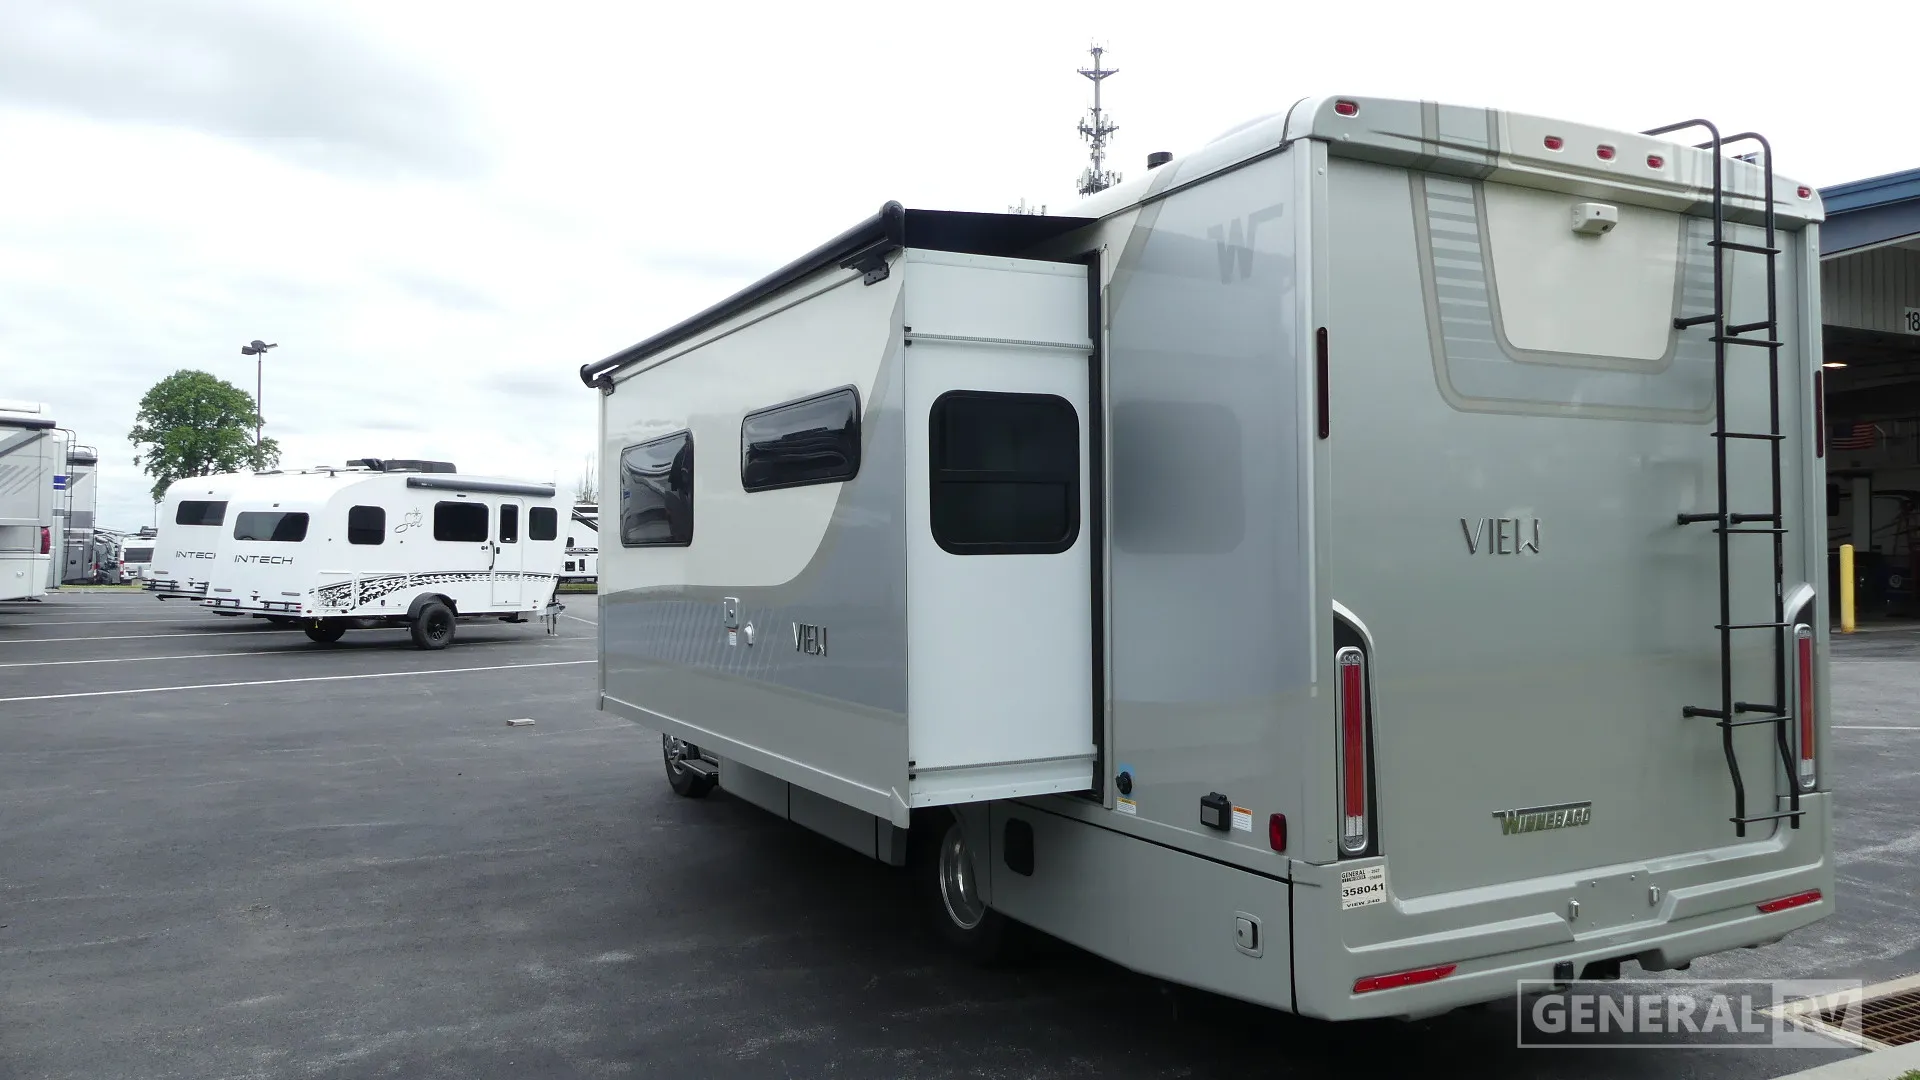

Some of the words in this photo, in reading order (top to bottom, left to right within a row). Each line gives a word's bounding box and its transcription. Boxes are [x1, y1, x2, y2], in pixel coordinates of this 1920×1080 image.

[1460, 517, 1540, 555] VIEW
[234, 554, 294, 564] INTECH
[792, 621, 827, 657] VIEW
[1342, 882, 1384, 897] 358041
